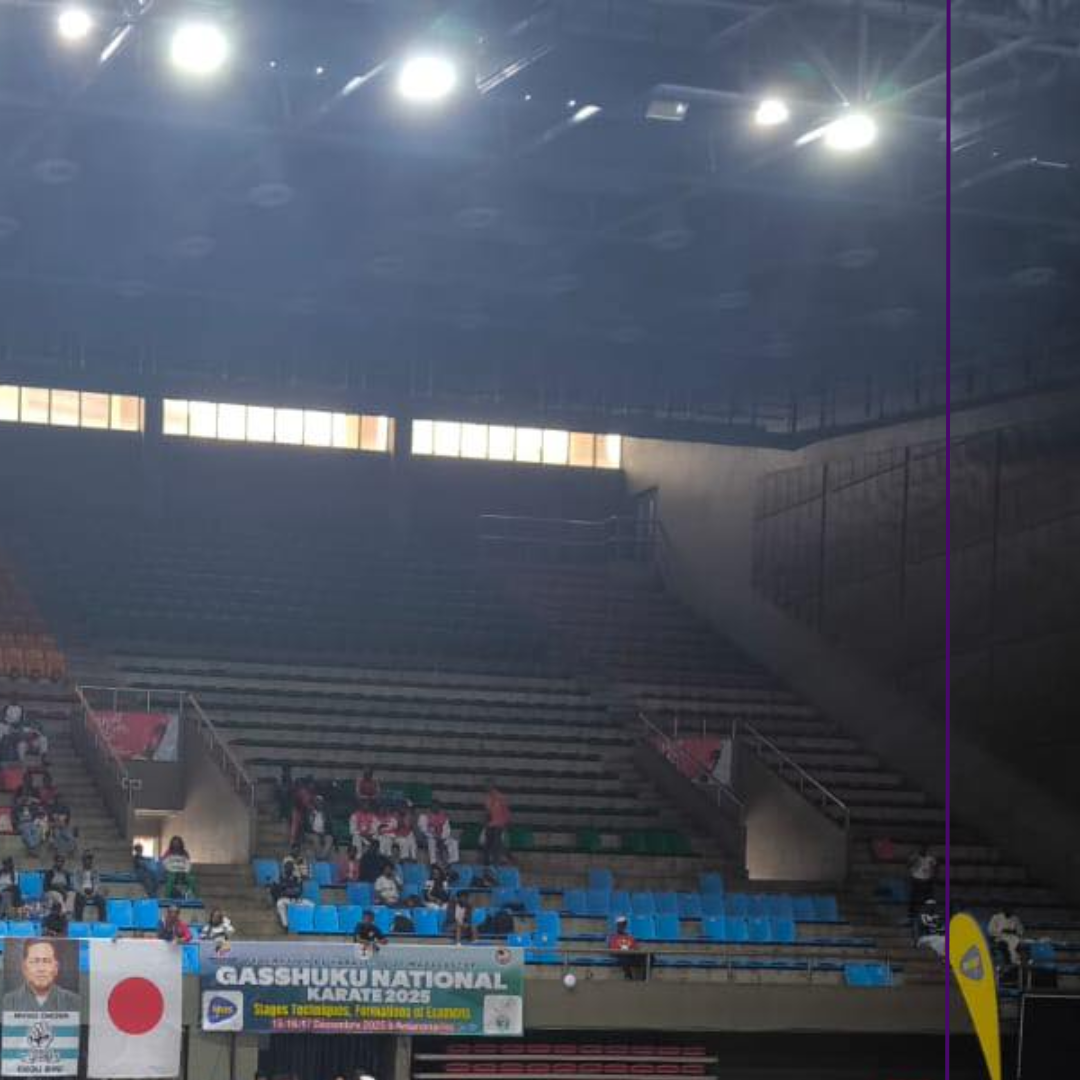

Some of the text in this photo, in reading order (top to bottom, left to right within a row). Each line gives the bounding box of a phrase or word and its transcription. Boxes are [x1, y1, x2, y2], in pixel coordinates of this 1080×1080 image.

[216, 966, 507, 990] GASSHUKU NATIONAL
[307, 987, 431, 1004] KARATE 2025
[253, 1002, 288, 1016] Stages
